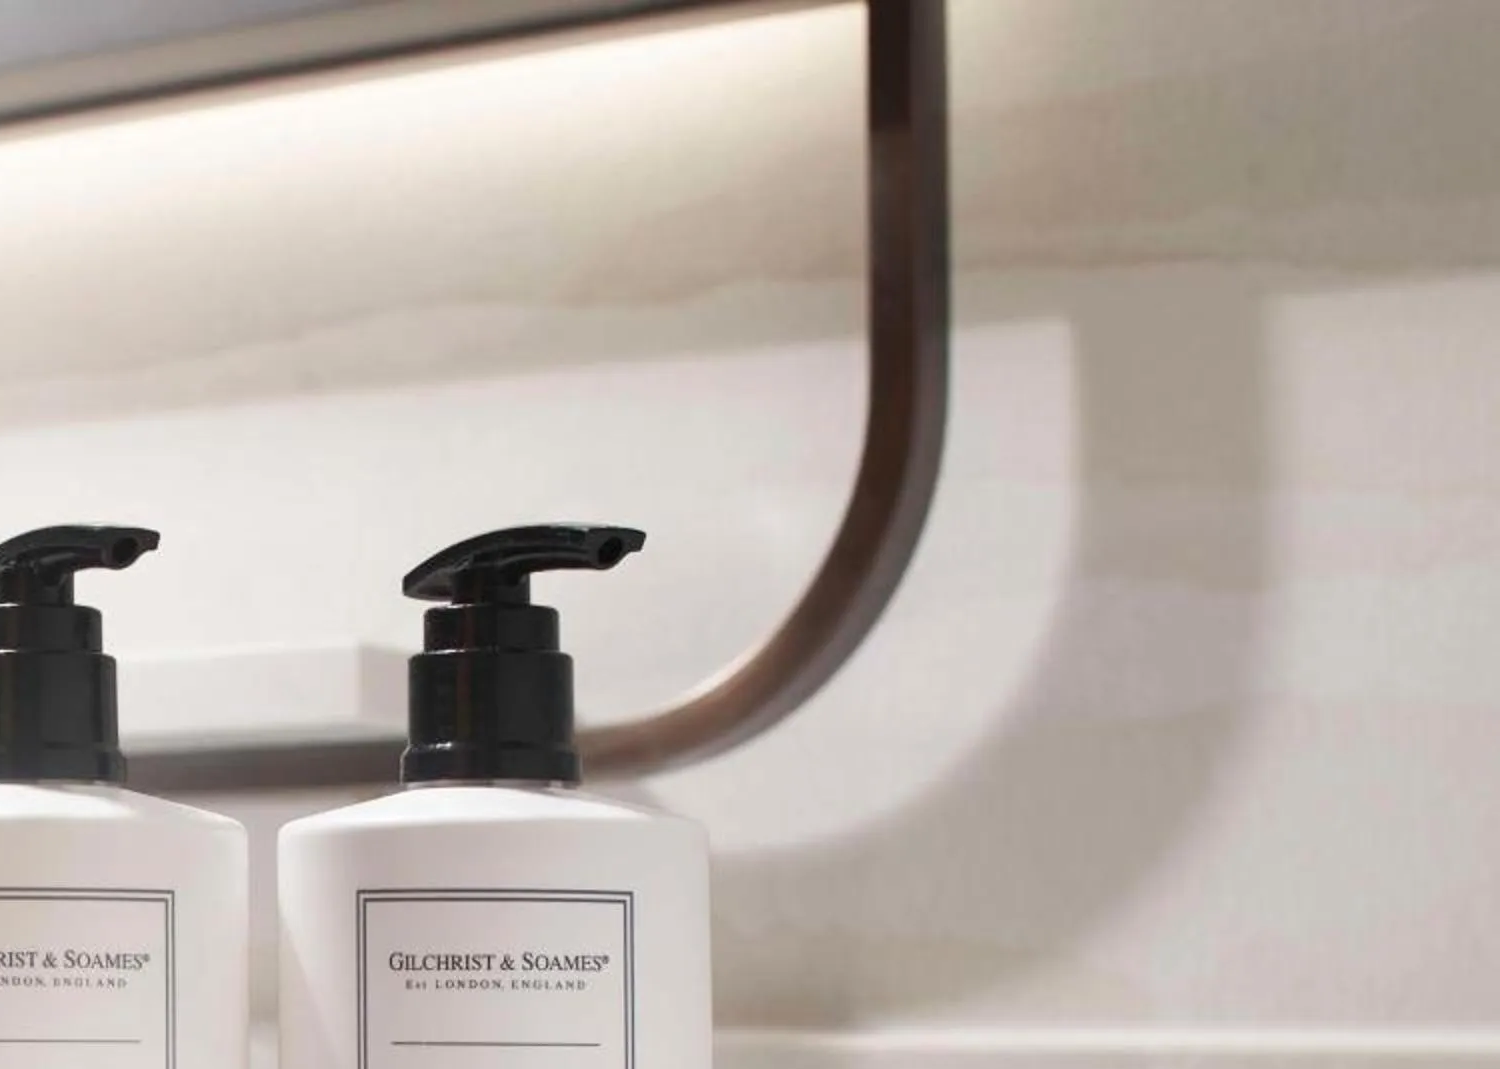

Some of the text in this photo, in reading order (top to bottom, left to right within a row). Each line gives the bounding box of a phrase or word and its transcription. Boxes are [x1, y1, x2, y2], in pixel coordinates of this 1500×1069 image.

[42, 952, 58, 969] &
[389, 952, 496, 971] GILCHRIST
[500, 954, 515, 971] &
[511, 979, 587, 991] ENGLAND
